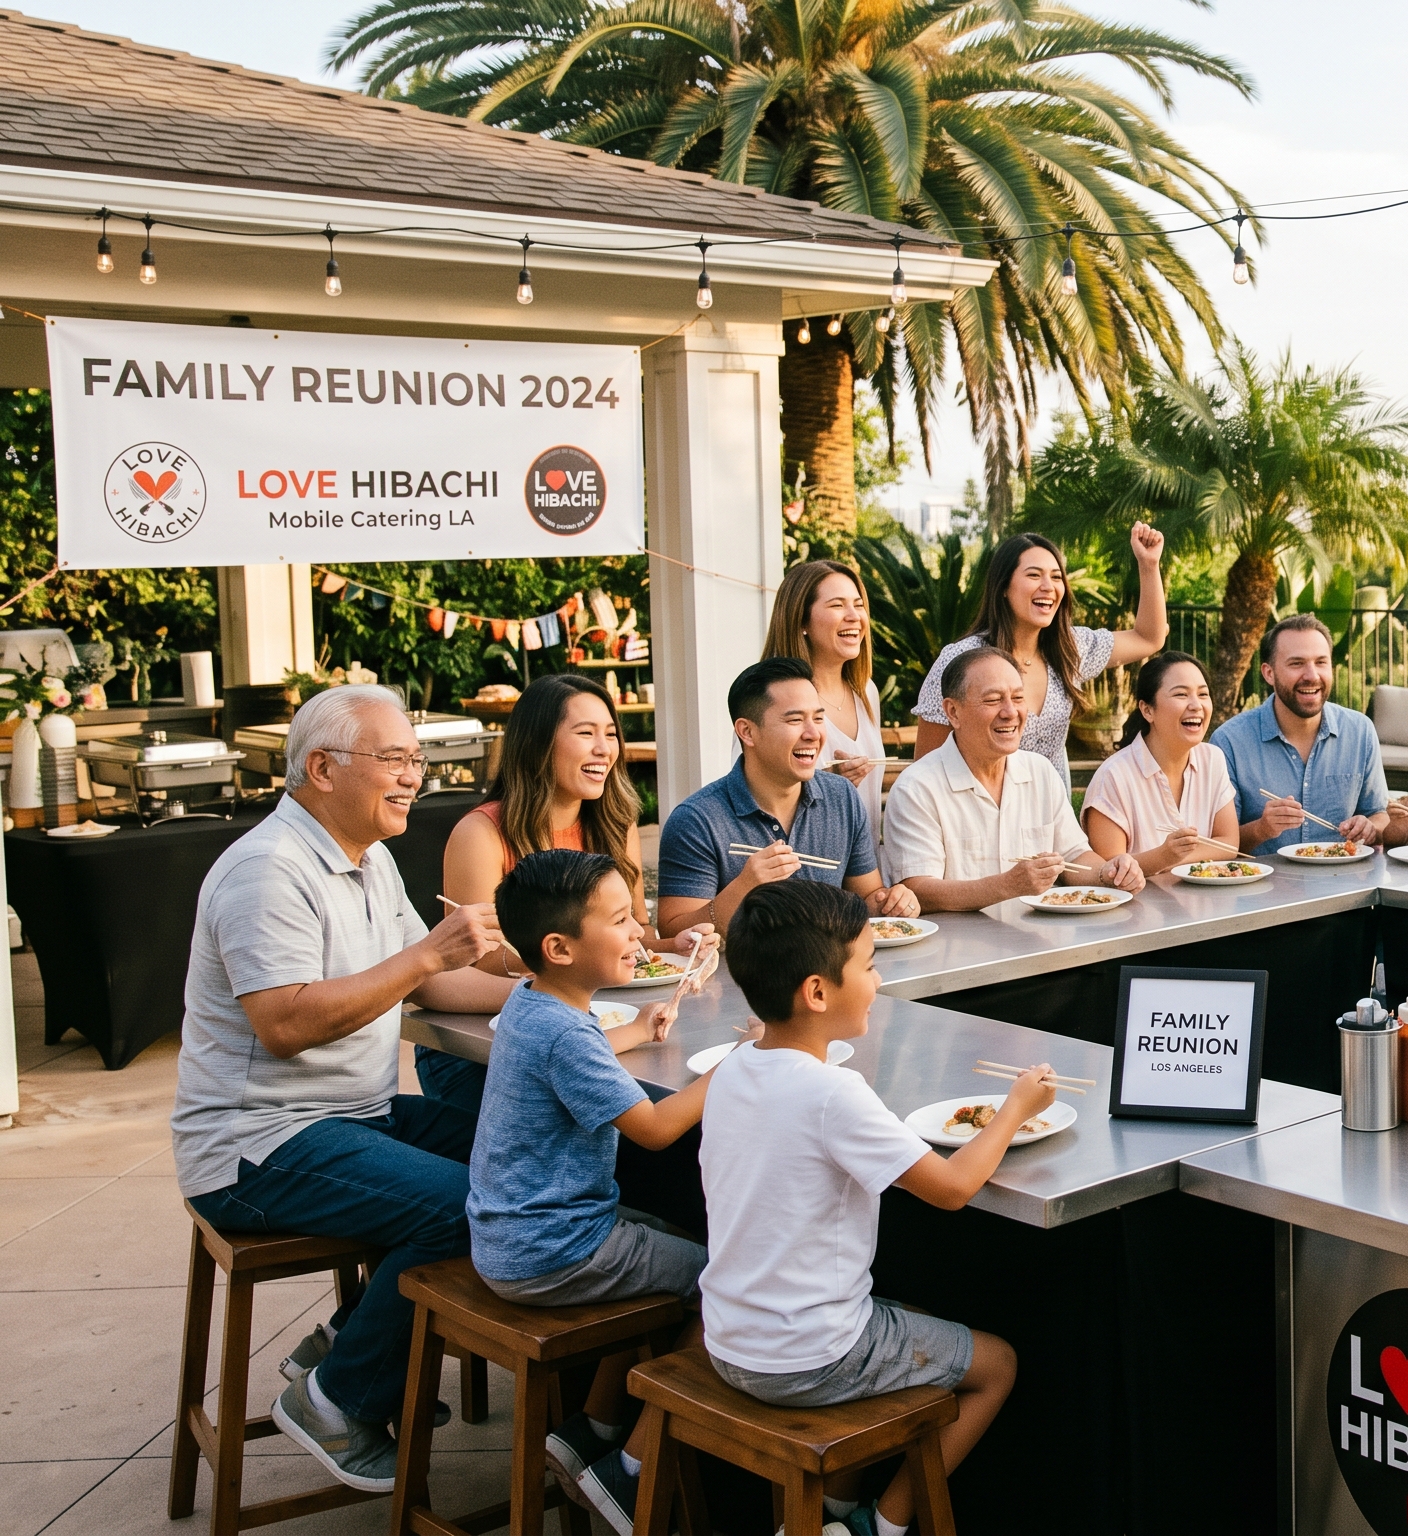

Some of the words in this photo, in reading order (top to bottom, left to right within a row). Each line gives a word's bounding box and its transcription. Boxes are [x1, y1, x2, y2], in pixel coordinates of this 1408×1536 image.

[82, 357, 275, 402] FAMILY
[291, 366, 506, 407] REUNION
[519, 374, 620, 410] 2024
[121, 448, 187, 472] LOVE
[237, 469, 338, 499] LOVE
[351, 470, 498, 499] HIBACHI
[534, 493, 597, 507] HIBACHI
[115, 507, 198, 538] HIBACHI
[269, 509, 344, 529] Mobile
[350, 508, 442, 532] Catering
[449, 509, 475, 526] LA
[1150, 1012, 1230, 1030] FAMILY
[1137, 1036, 1238, 1055] REUNION
[1151, 1063, 1171, 1072] LOS
[1174, 1063, 1222, 1074] ANGELES
